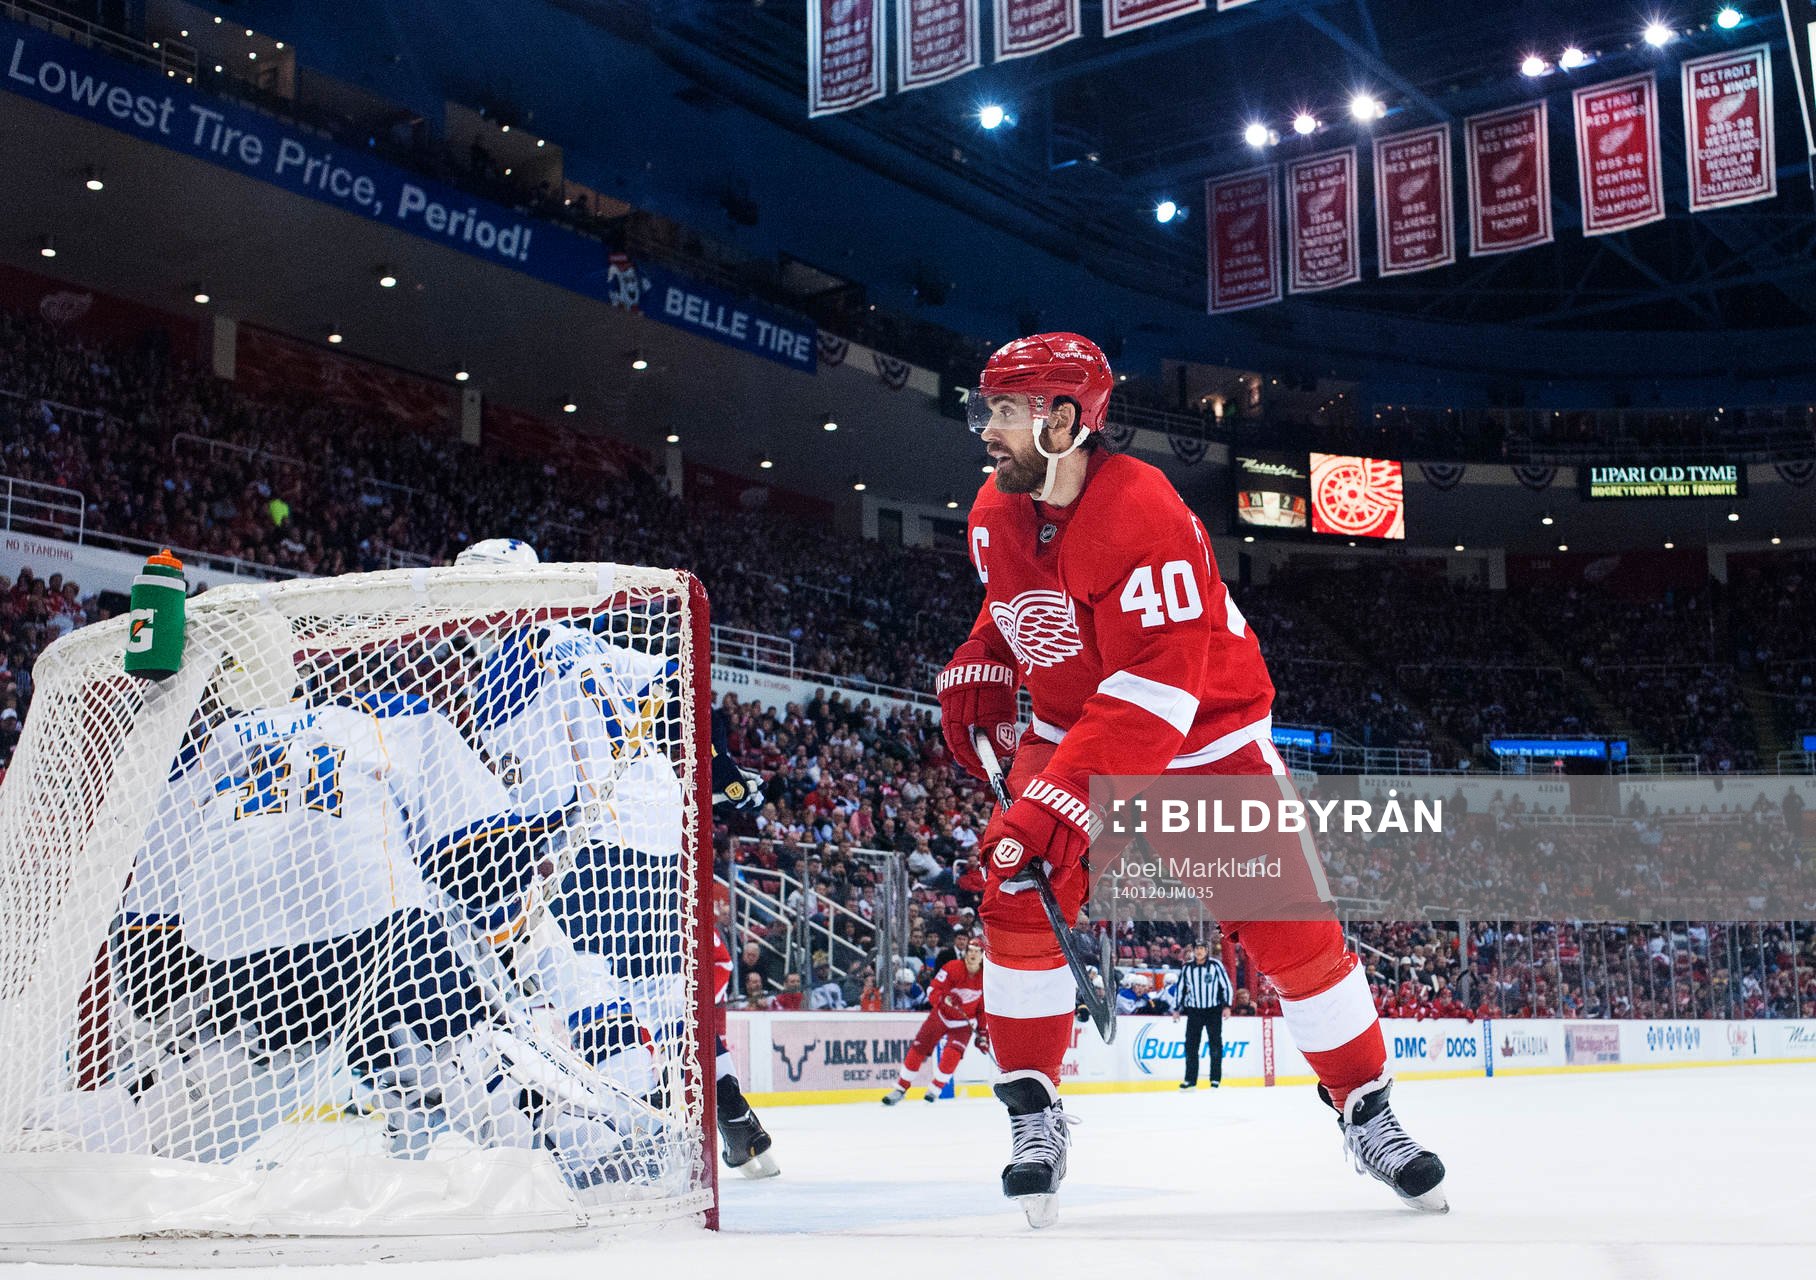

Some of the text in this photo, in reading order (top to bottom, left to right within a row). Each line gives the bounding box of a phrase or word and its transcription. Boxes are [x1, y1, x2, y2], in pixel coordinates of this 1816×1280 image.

[1700, 64, 1752, 84] DETROIT
[1696, 76, 1758, 100] RED WINGS
[1591, 92, 1638, 113] DETROIT
[1586, 104, 1646, 128] RED WINGS
[8, 38, 532, 262] Lowest Tire Price, Period!
[1597, 167, 1643, 186] CENTRAL
[665, 287, 811, 362] BELLE TIRE
[1591, 465, 1737, 482] LIPARI OLD TYME
[1591, 483, 1737, 497] HOCKEYTOWN'S DELI FAVORITE
[6, 539, 74, 561] NO STANDING
[971, 526, 990, 584] C
[1119, 559, 1204, 628] 40
[126, 608, 155, 653] G
[824, 1040, 867, 1065] JACK
[1394, 1036, 1427, 1058] DMC
[1446, 1037, 1476, 1058] DOCS
[844, 1070, 872, 1080] BEEF
[1060, 1060, 1080, 1076] ank
